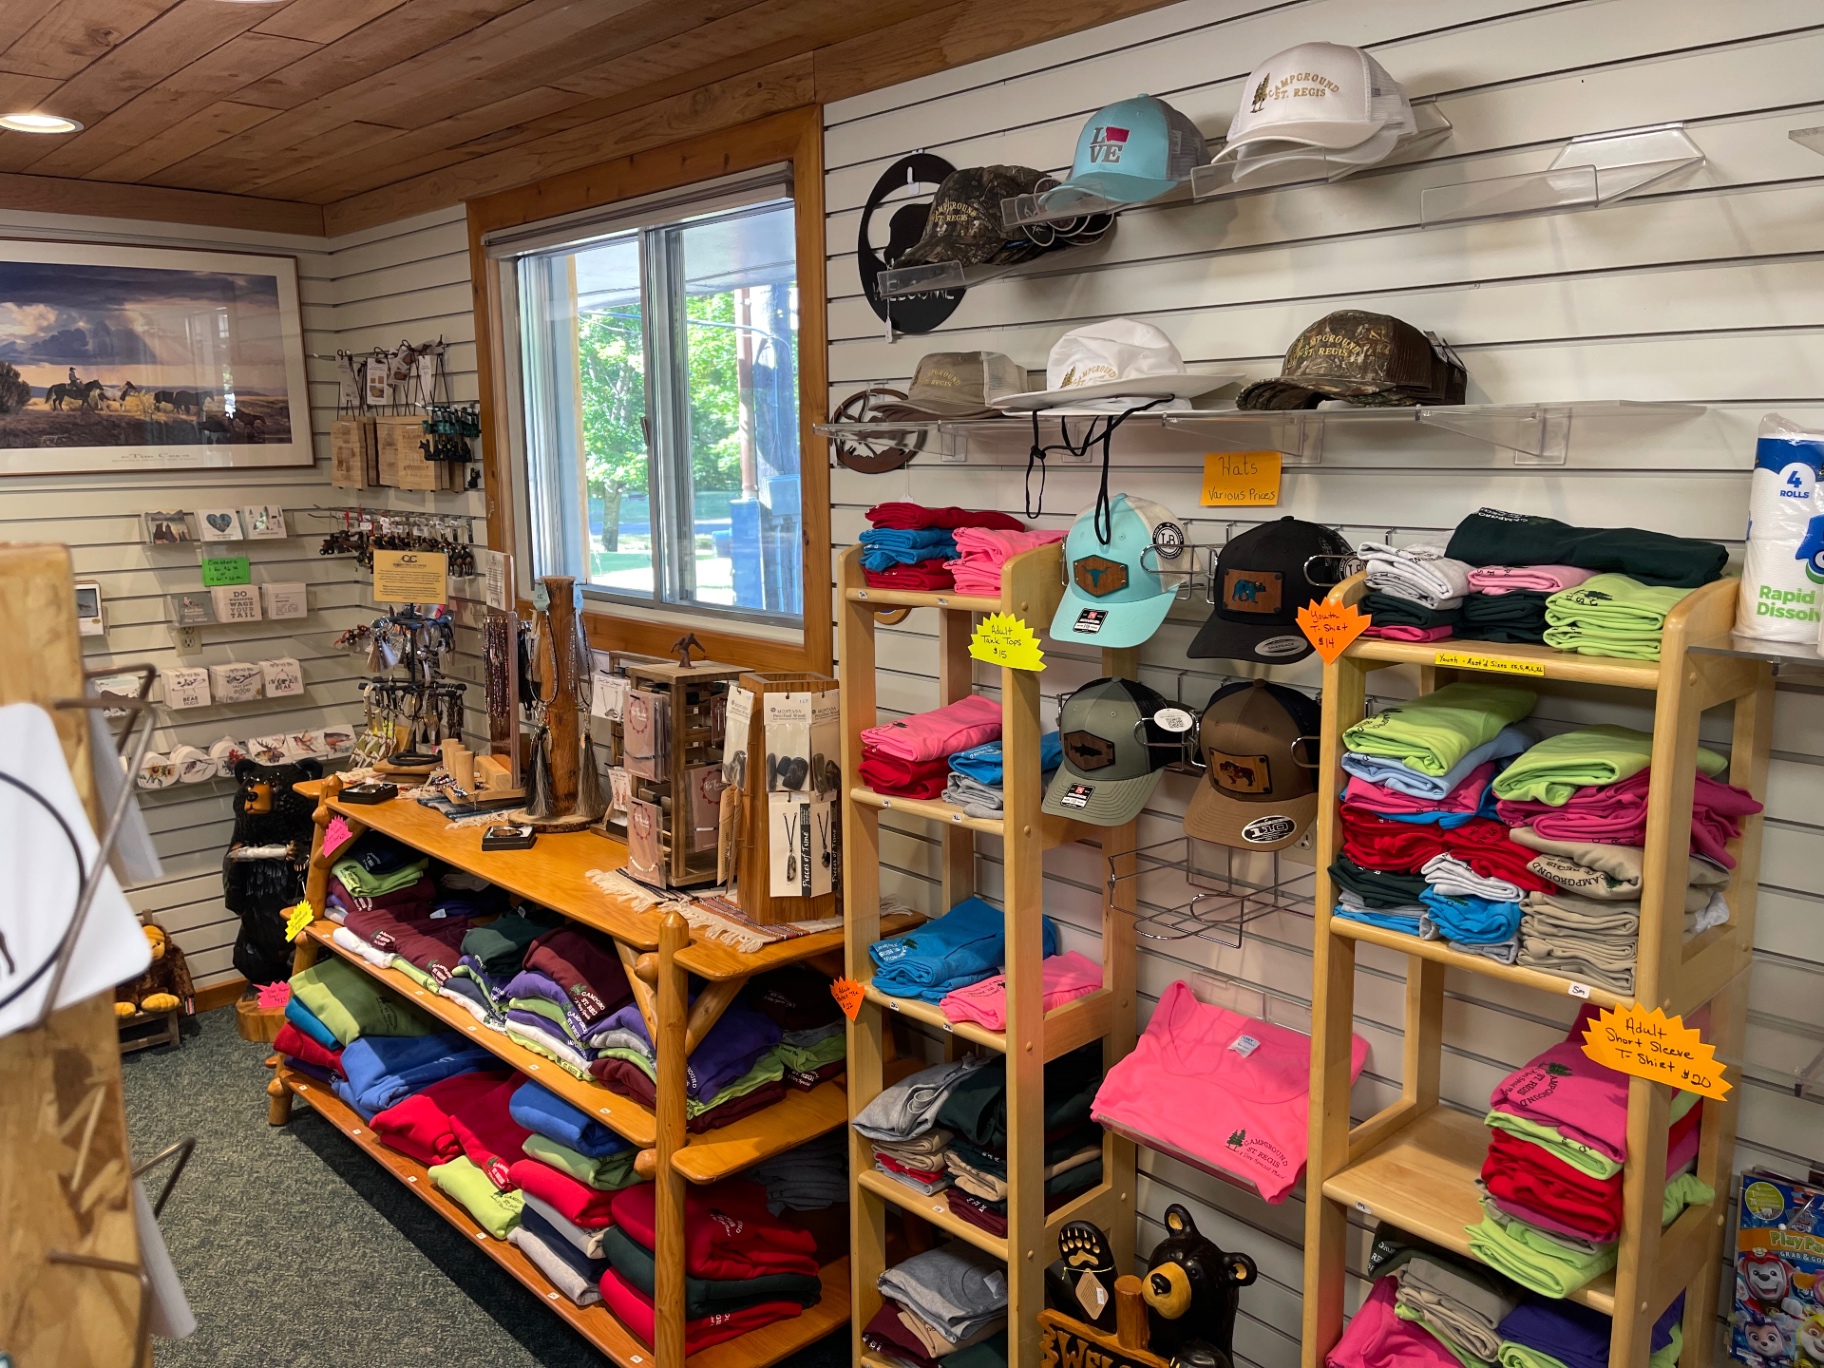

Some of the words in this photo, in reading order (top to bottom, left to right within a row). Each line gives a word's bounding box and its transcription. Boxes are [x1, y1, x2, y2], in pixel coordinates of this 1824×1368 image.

[1268, 72, 1340, 98] CAMPGROUND
[1273, 88, 1289, 100] ST.
[1293, 87, 1326, 98] REGIS
[1318, 347, 1349, 357] REGIS
[1218, 454, 1258, 476] Hats
[1786, 470, 1802, 488] 4
[1208, 486, 1246, 501] Various
[1249, 487, 1276, 501] Prices
[1779, 489, 1810, 499] ROLLS
[233, 590, 247, 598] DO
[1759, 585, 1816, 604] Rapid
[1310, 610, 1340, 623] Youth
[991, 624, 1013, 635] Adult
[981, 635, 1000, 644] Tank
[1002, 637, 1022, 646] Tops
[1318, 637, 1335, 648] $14
[993, 647, 1007, 658] $15
[1532, 861, 1605, 887] CAMPGROUND
[1625, 1017, 1667, 1039] Adult
[1605, 1027, 1642, 1047] Short
[1650, 1041, 1694, 1060] Sleeve
[1681, 1069, 1711, 1089] $20
[1519, 1074, 1559, 1107] AMPGROUND
[1243, 1138, 1288, 1167] CAMPGROUND
[1257, 1151, 1280, 1168] REGIS
[1769, 1230, 1804, 1251] Play
[1780, 1250, 1801, 1259] GRAB
